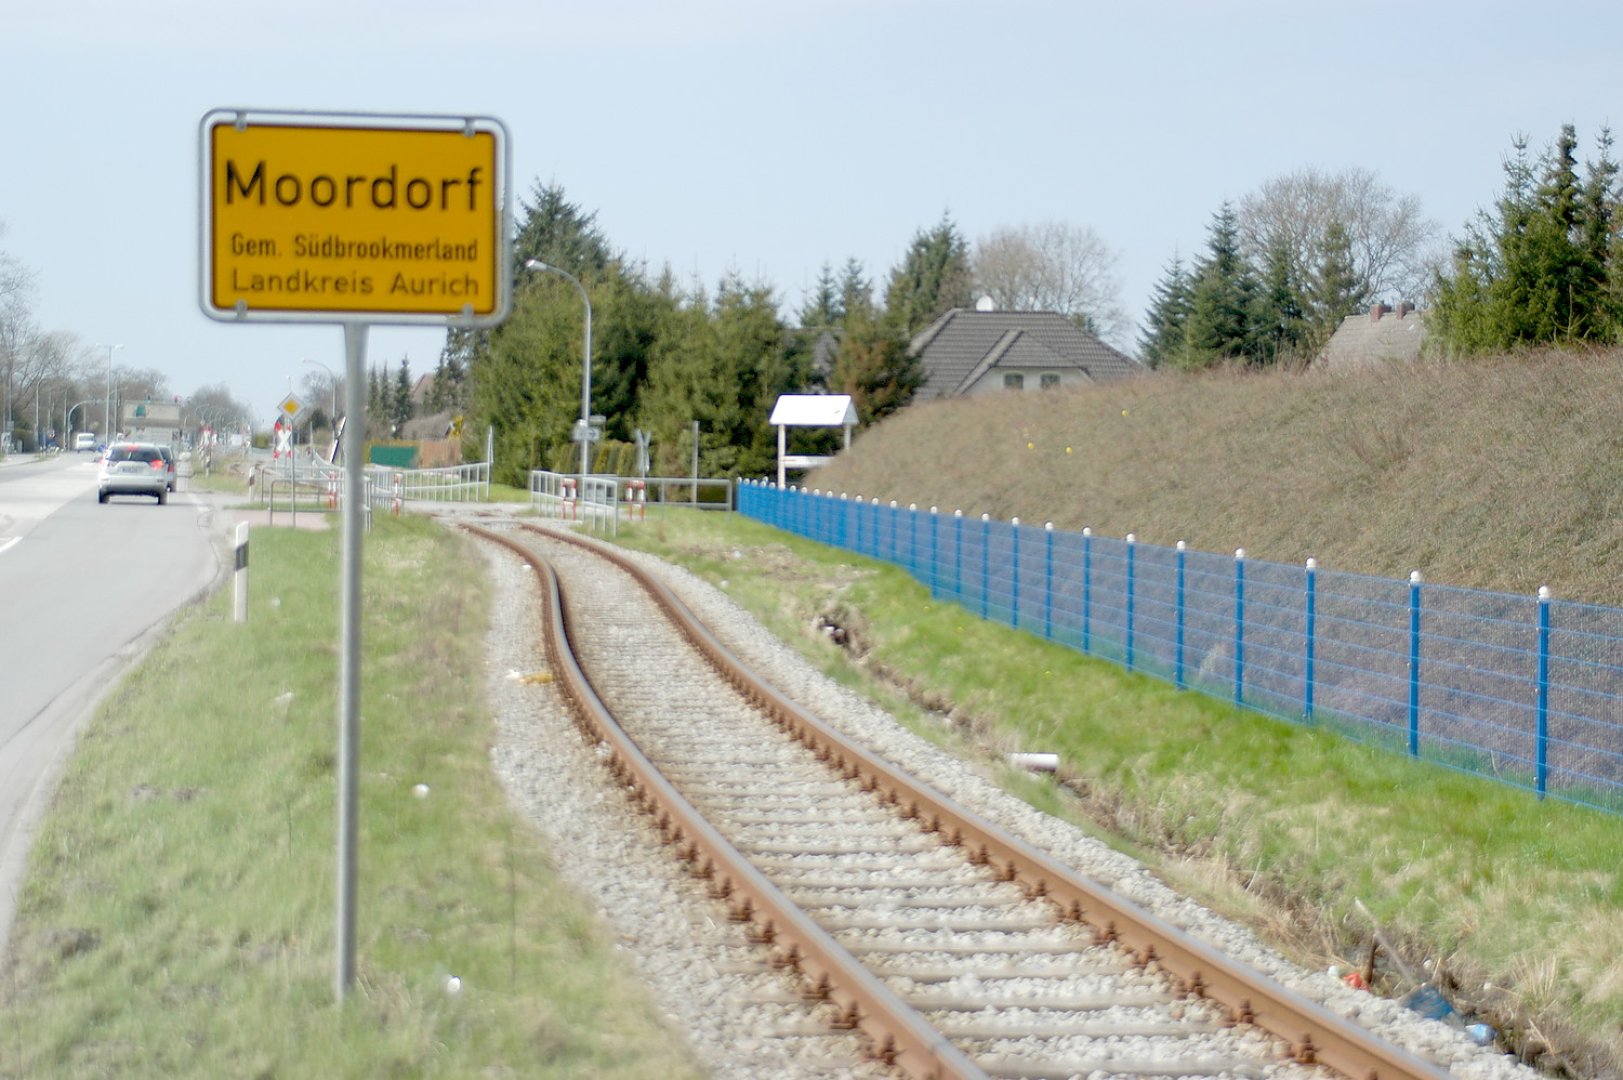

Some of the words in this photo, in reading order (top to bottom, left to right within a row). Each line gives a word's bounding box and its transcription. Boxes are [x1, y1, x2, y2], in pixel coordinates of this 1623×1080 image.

[225, 159, 483, 211] Moordorf
[232, 233, 282, 258] Gem.
[294, 234, 478, 261] Südbrookmerland
[232, 268, 374, 295] Landkreis
[390, 272, 479, 297] Aurich
